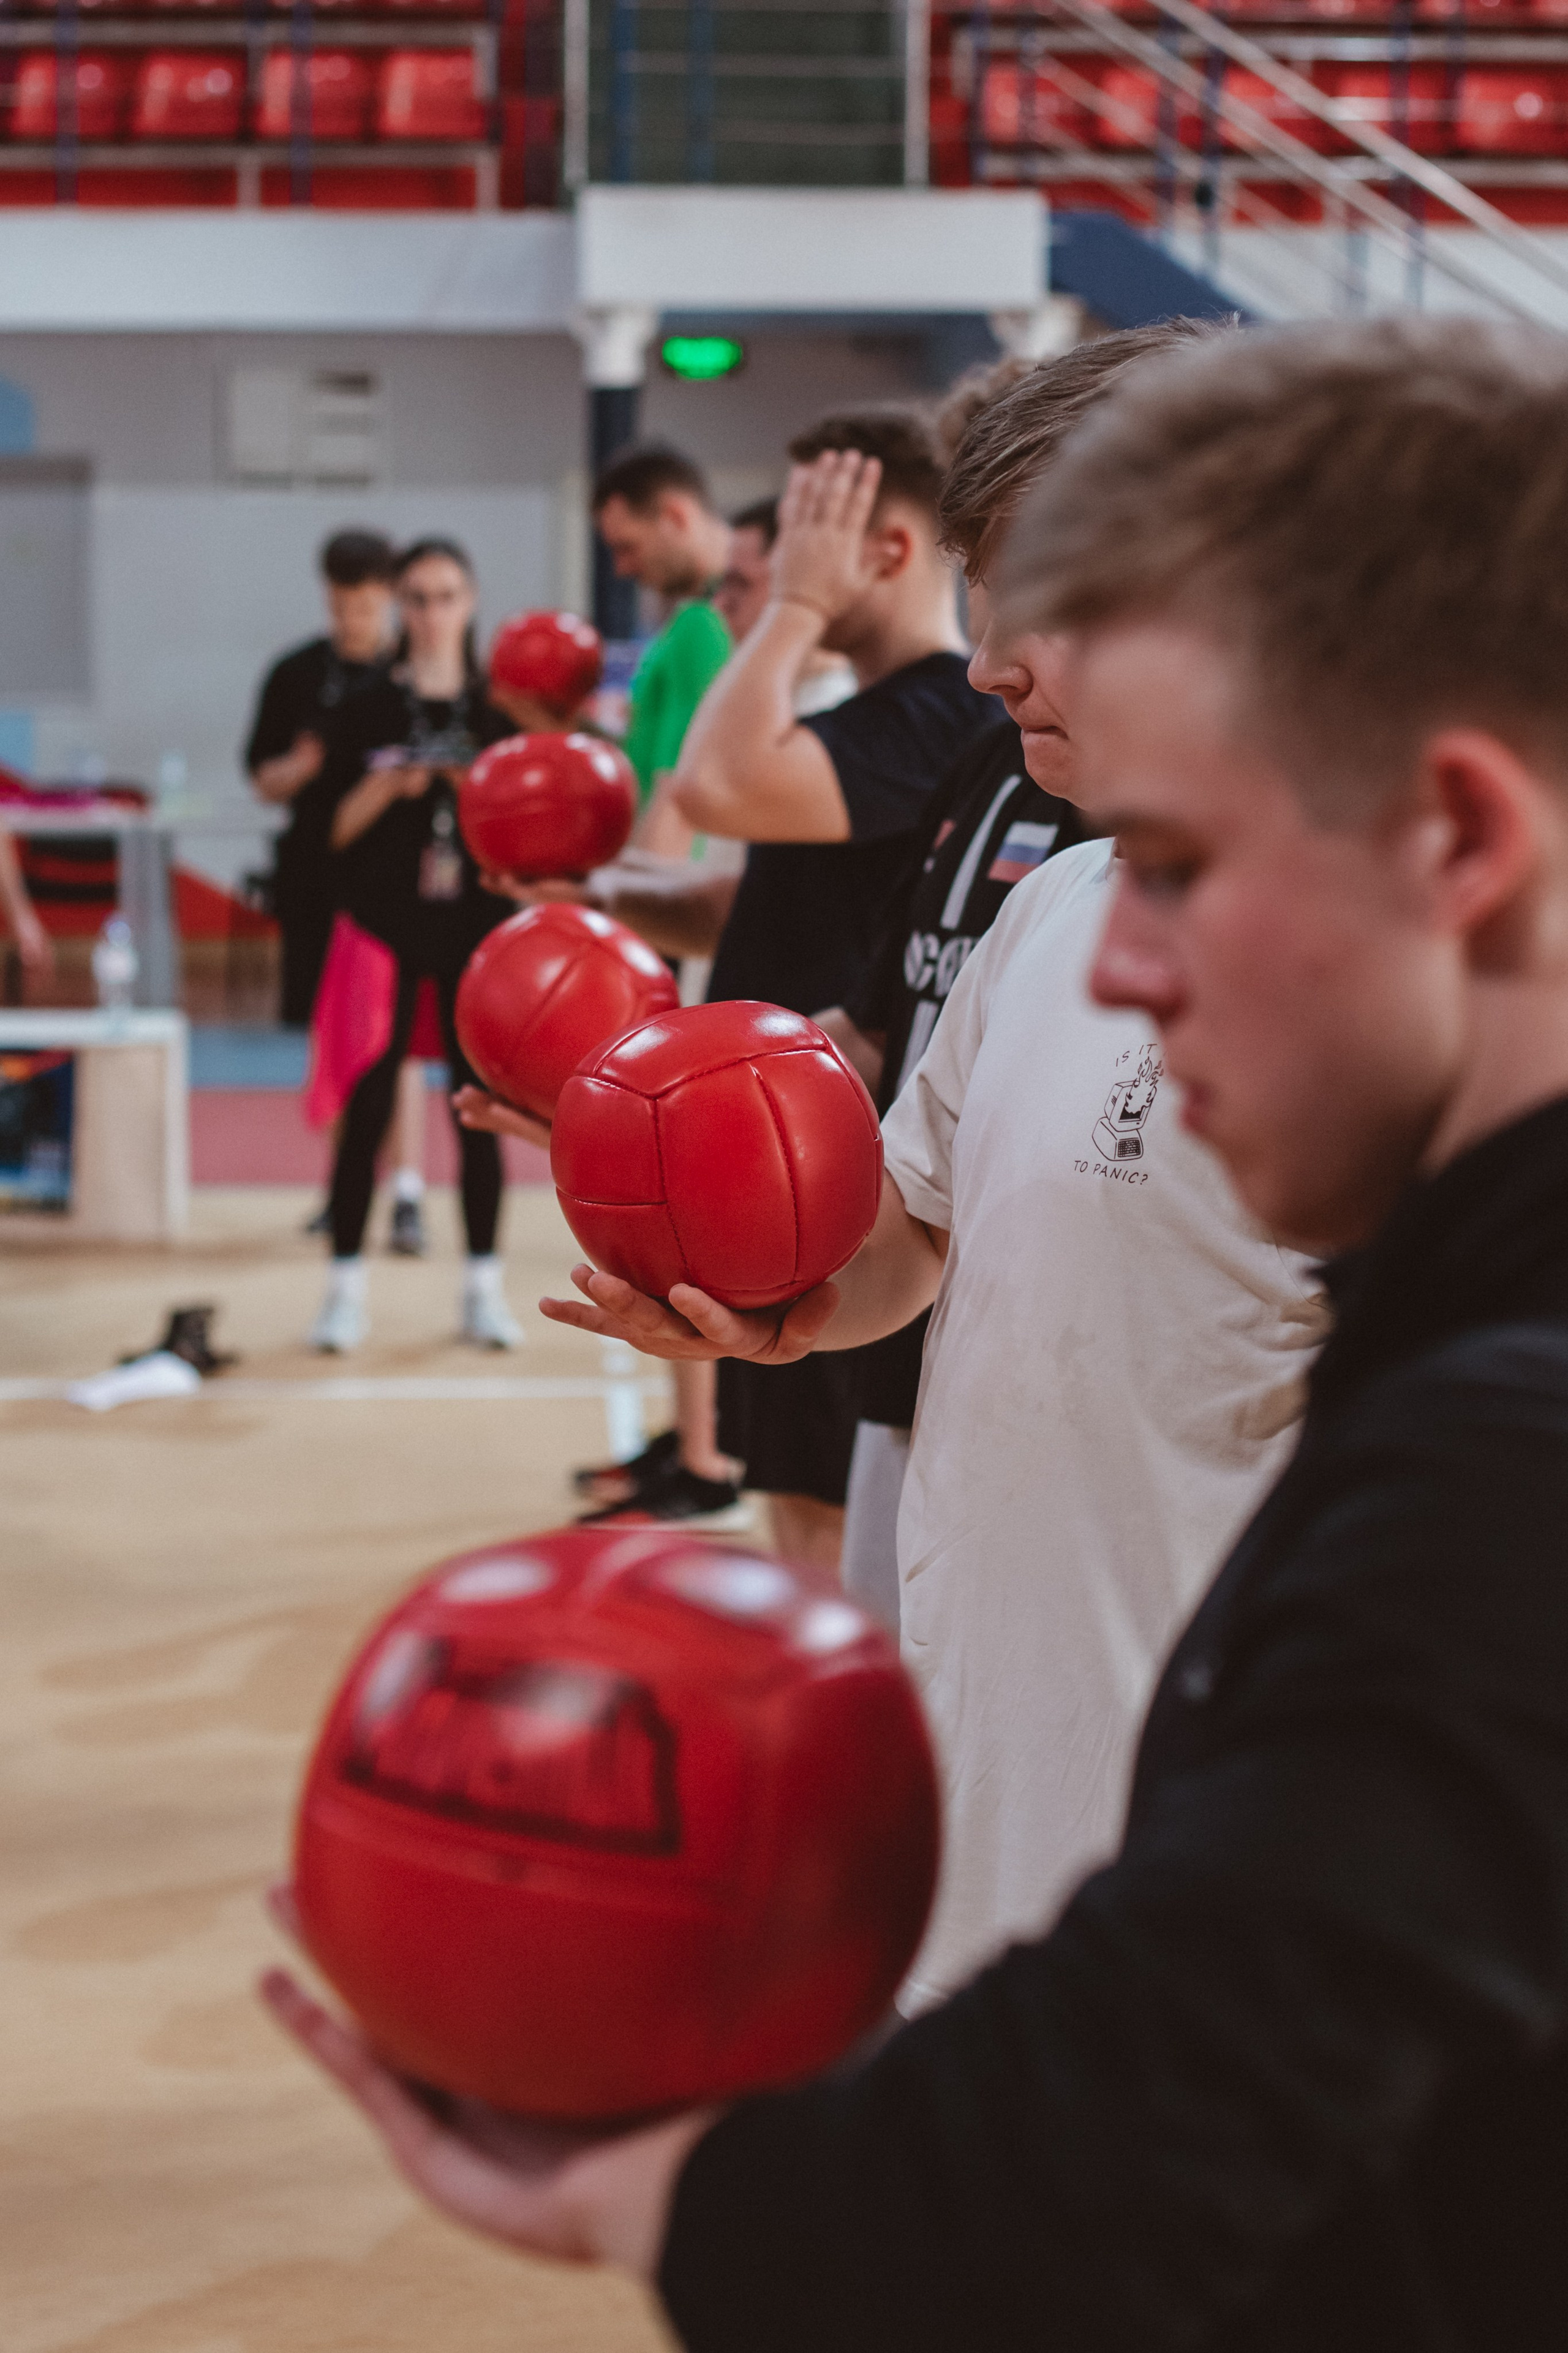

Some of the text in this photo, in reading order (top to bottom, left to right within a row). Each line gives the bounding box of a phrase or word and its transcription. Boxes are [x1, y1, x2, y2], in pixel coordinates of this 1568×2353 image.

[1115, 1043, 1158, 1067] IS IT
[1074, 1160, 1148, 1185] TO PANIC?
